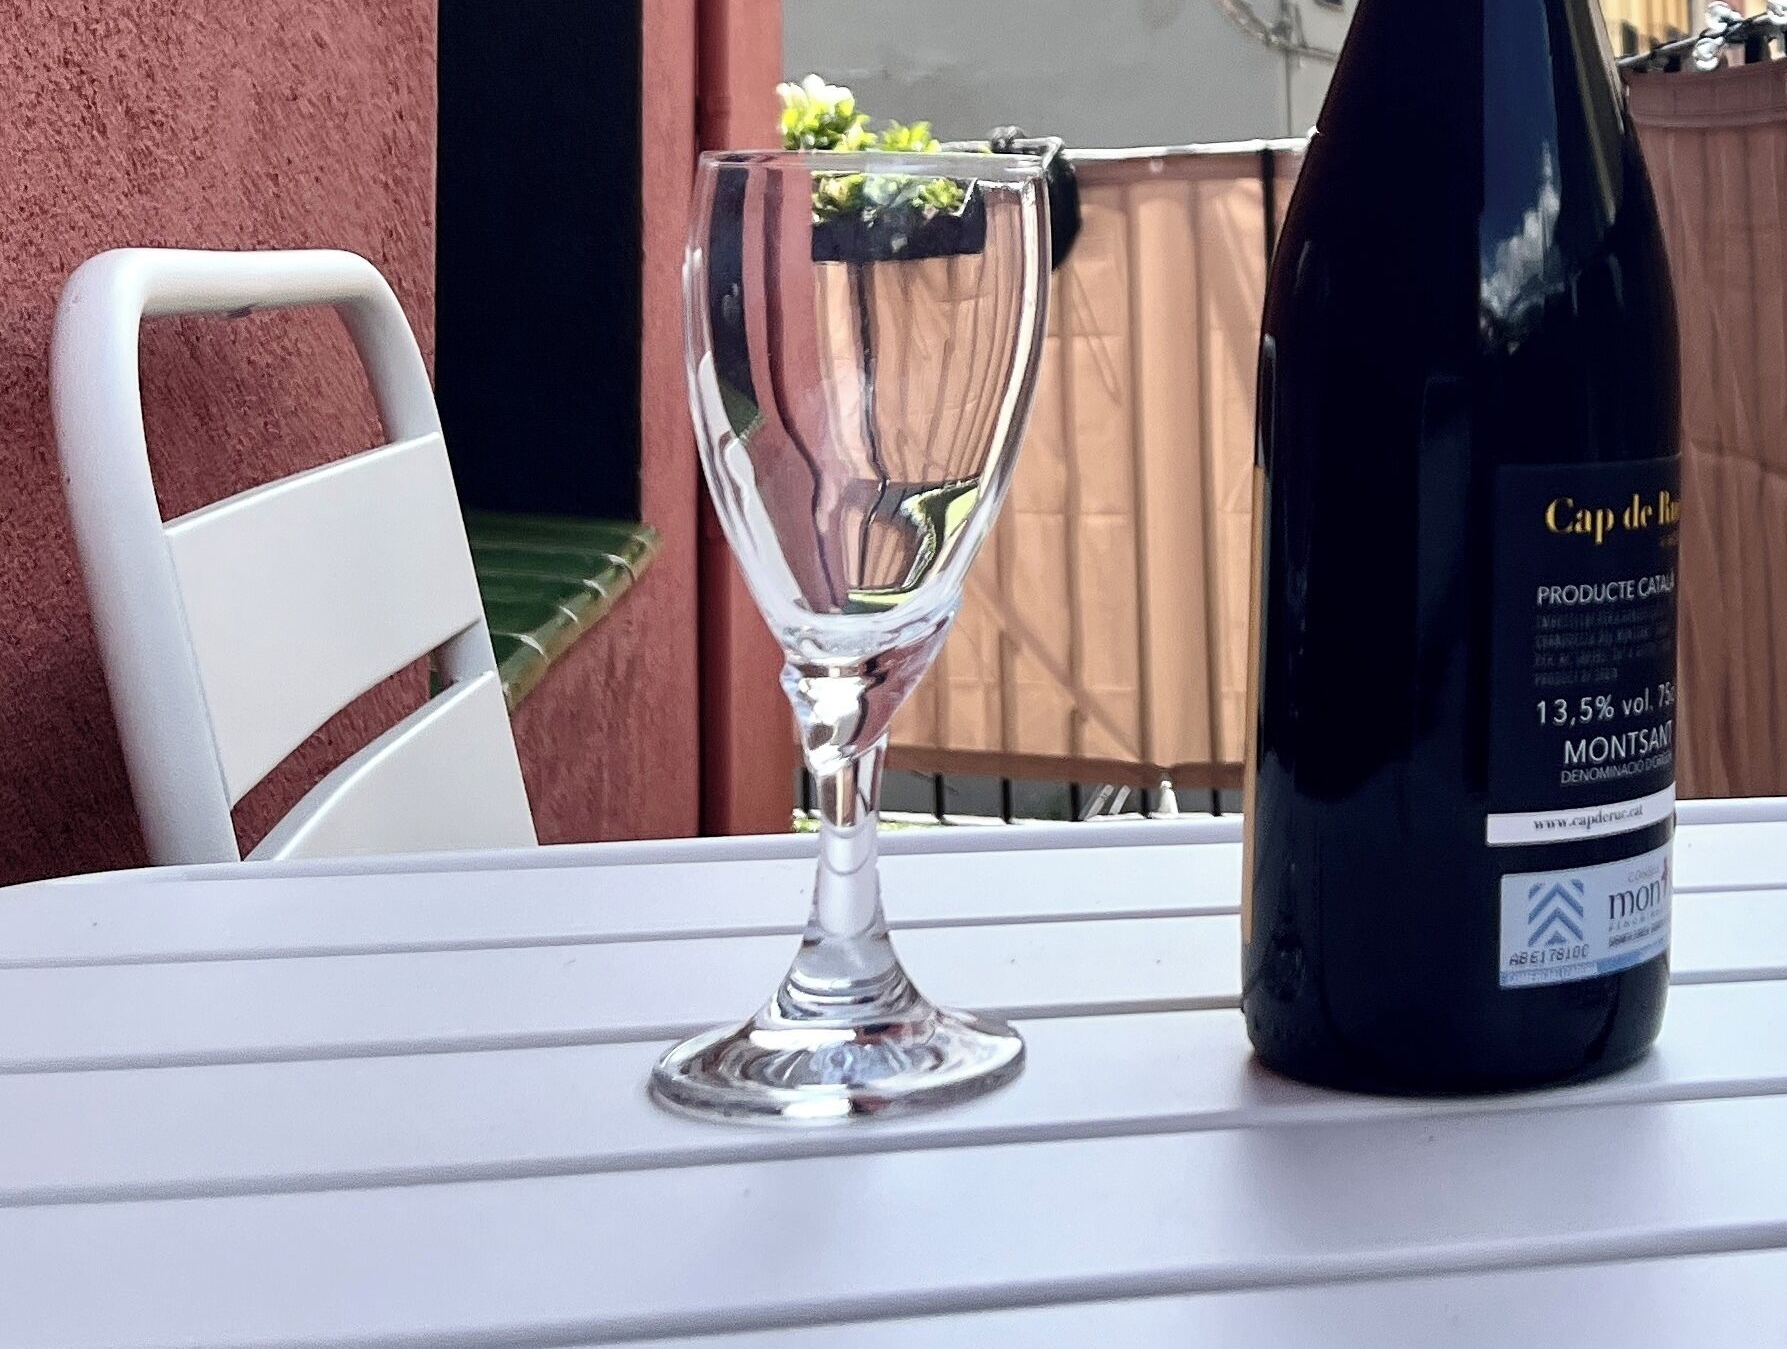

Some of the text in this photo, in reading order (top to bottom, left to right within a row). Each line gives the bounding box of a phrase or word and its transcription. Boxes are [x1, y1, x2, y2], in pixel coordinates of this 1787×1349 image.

[1545, 497, 1616, 545] Cap
[1623, 492, 1654, 530] de
[1536, 579, 1636, 607] PRODUCTE
[1536, 694, 1615, 728] 13,5%
[1622, 687, 1654, 716] vol.
[1564, 720, 1672, 764] MONTSANT
